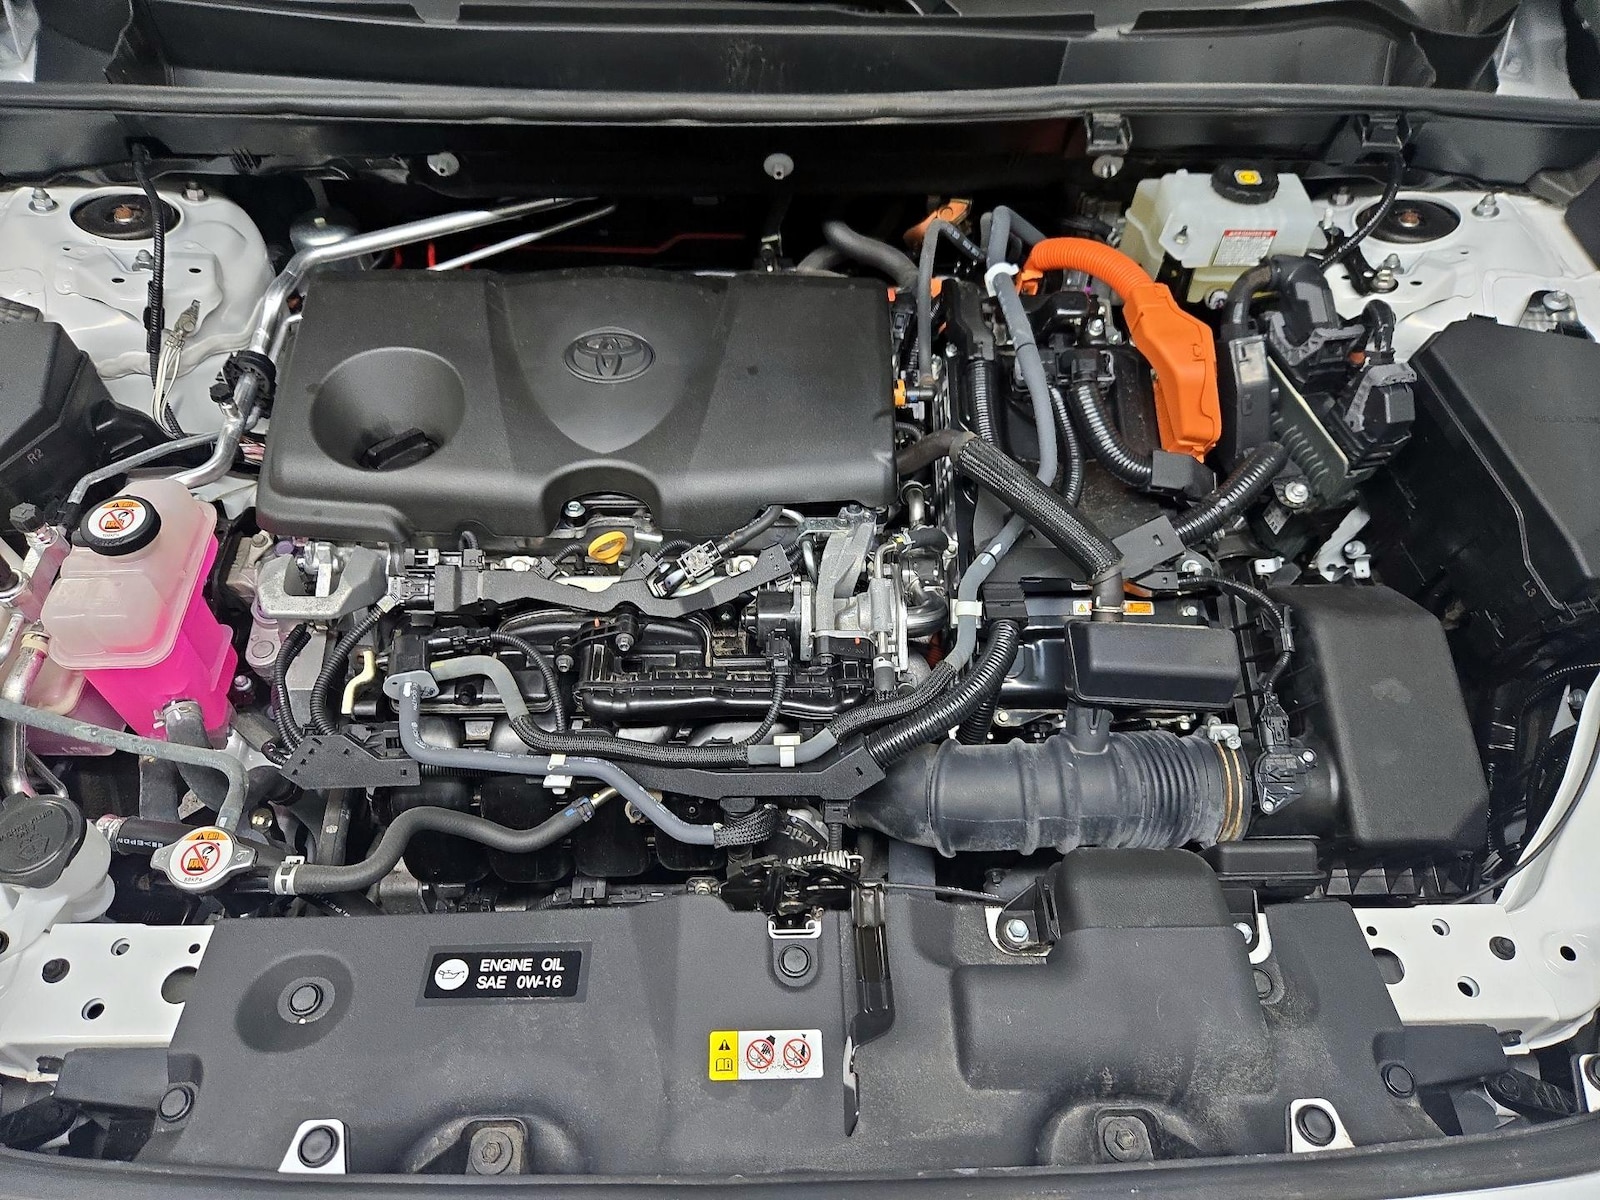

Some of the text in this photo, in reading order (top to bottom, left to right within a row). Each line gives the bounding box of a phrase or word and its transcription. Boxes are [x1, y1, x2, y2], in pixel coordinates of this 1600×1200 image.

[27, 448, 44, 465] R2
[1522, 580, 1537, 598] L3
[479, 957, 565, 972] ENGINE OIL
[476, 974, 562, 990] SAE 0W-16
